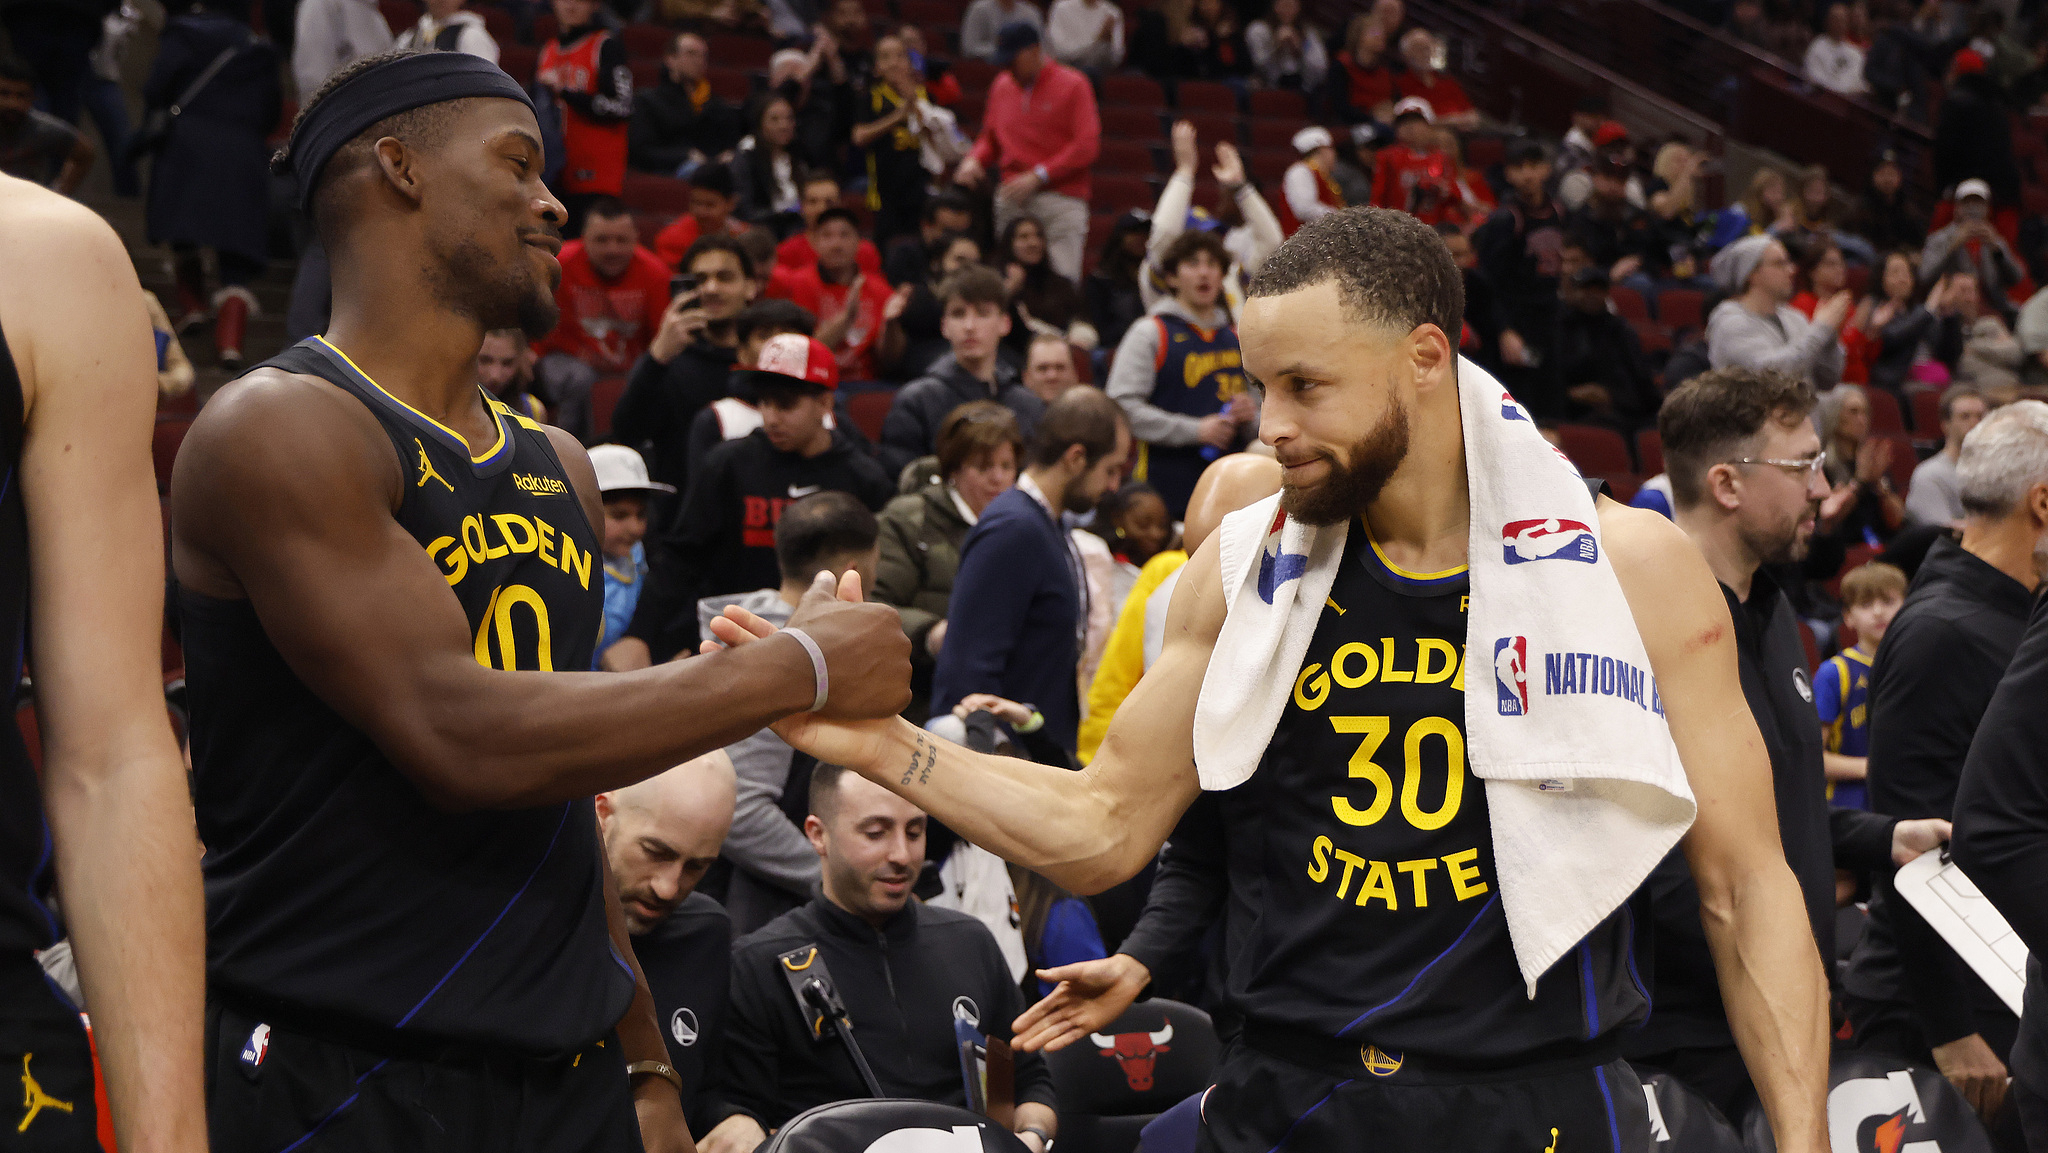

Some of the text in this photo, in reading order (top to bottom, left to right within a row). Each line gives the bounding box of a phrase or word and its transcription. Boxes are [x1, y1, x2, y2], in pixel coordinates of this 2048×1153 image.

[512, 472, 568, 494] Rakuten
[426, 513, 592, 591] GOLDEN
[1579, 538, 1595, 560] NBA
[1293, 637, 1467, 711] GOLD
[1501, 699, 1518, 713] NBA
[1545, 652, 1647, 711] NATIONAL
[1329, 715, 1464, 830] 30
[1307, 835, 1489, 911] STATE
